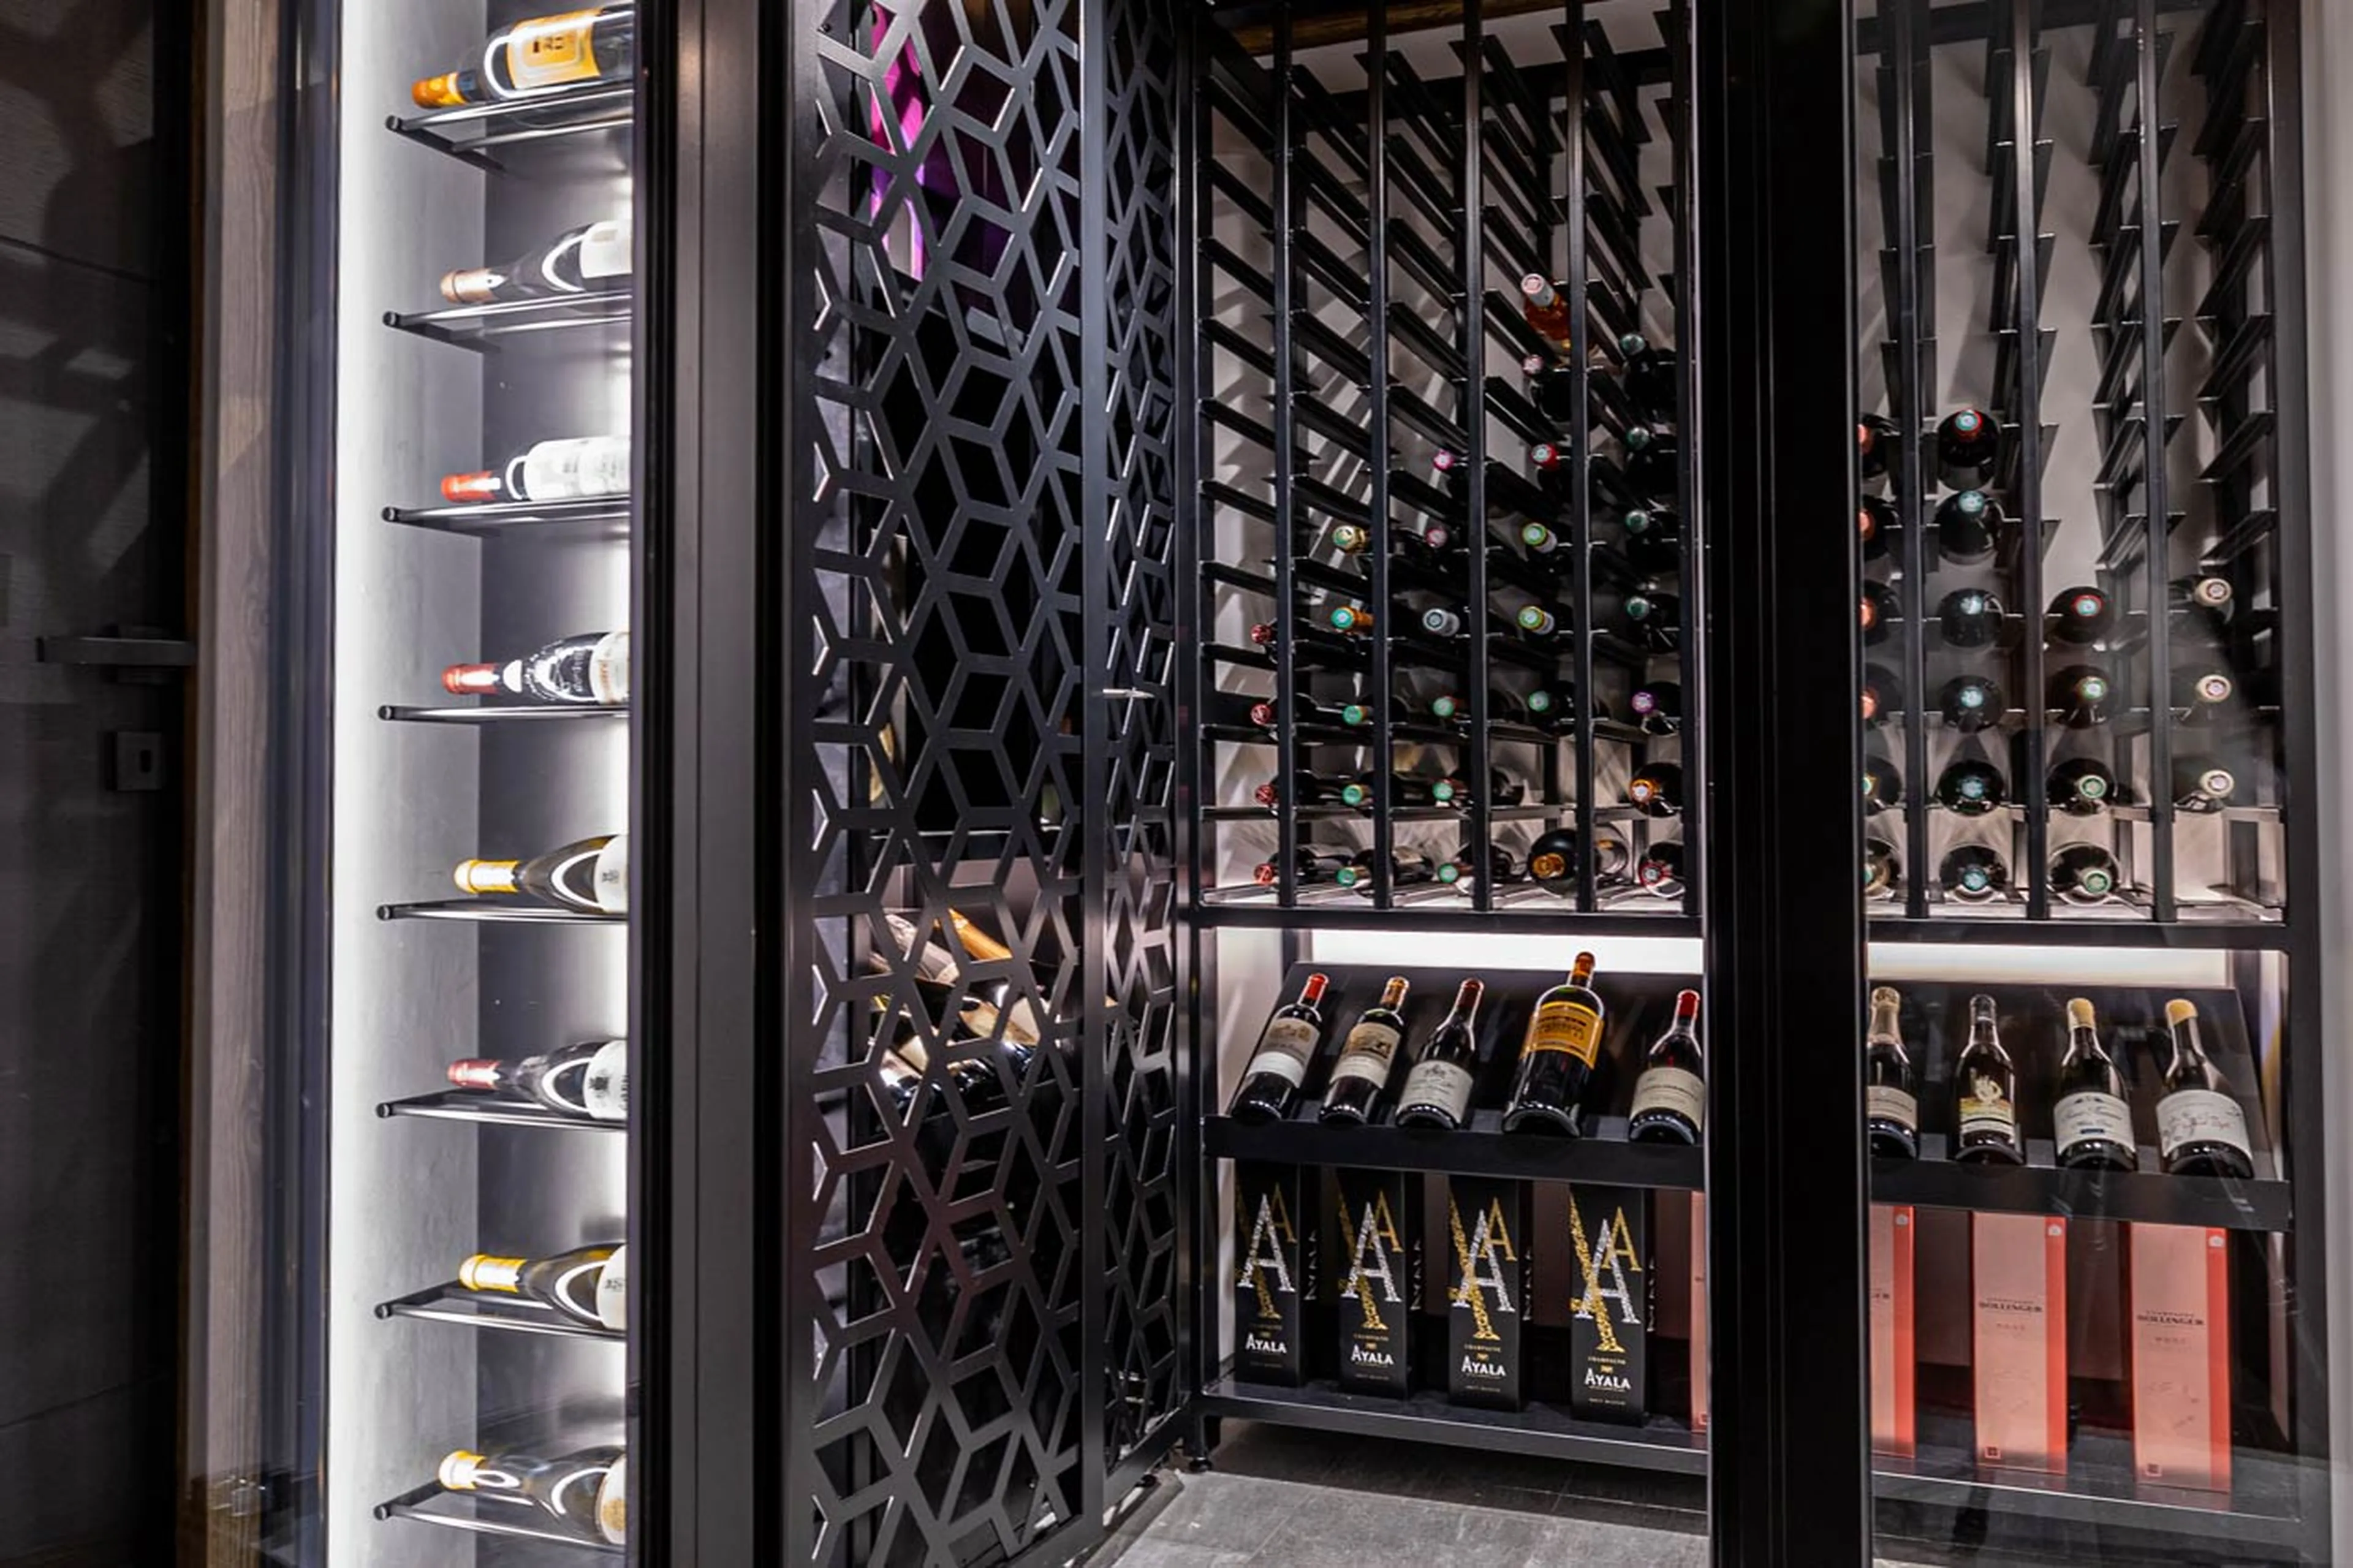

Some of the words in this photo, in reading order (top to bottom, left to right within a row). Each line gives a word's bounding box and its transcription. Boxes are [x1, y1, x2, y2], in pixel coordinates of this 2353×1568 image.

[1245, 1332, 1287, 1354] AYALA
[1351, 1343, 1395, 1366] AYALA
[1461, 1354, 1507, 1376] AYALA
[1584, 1367, 1631, 1390] AYALA
